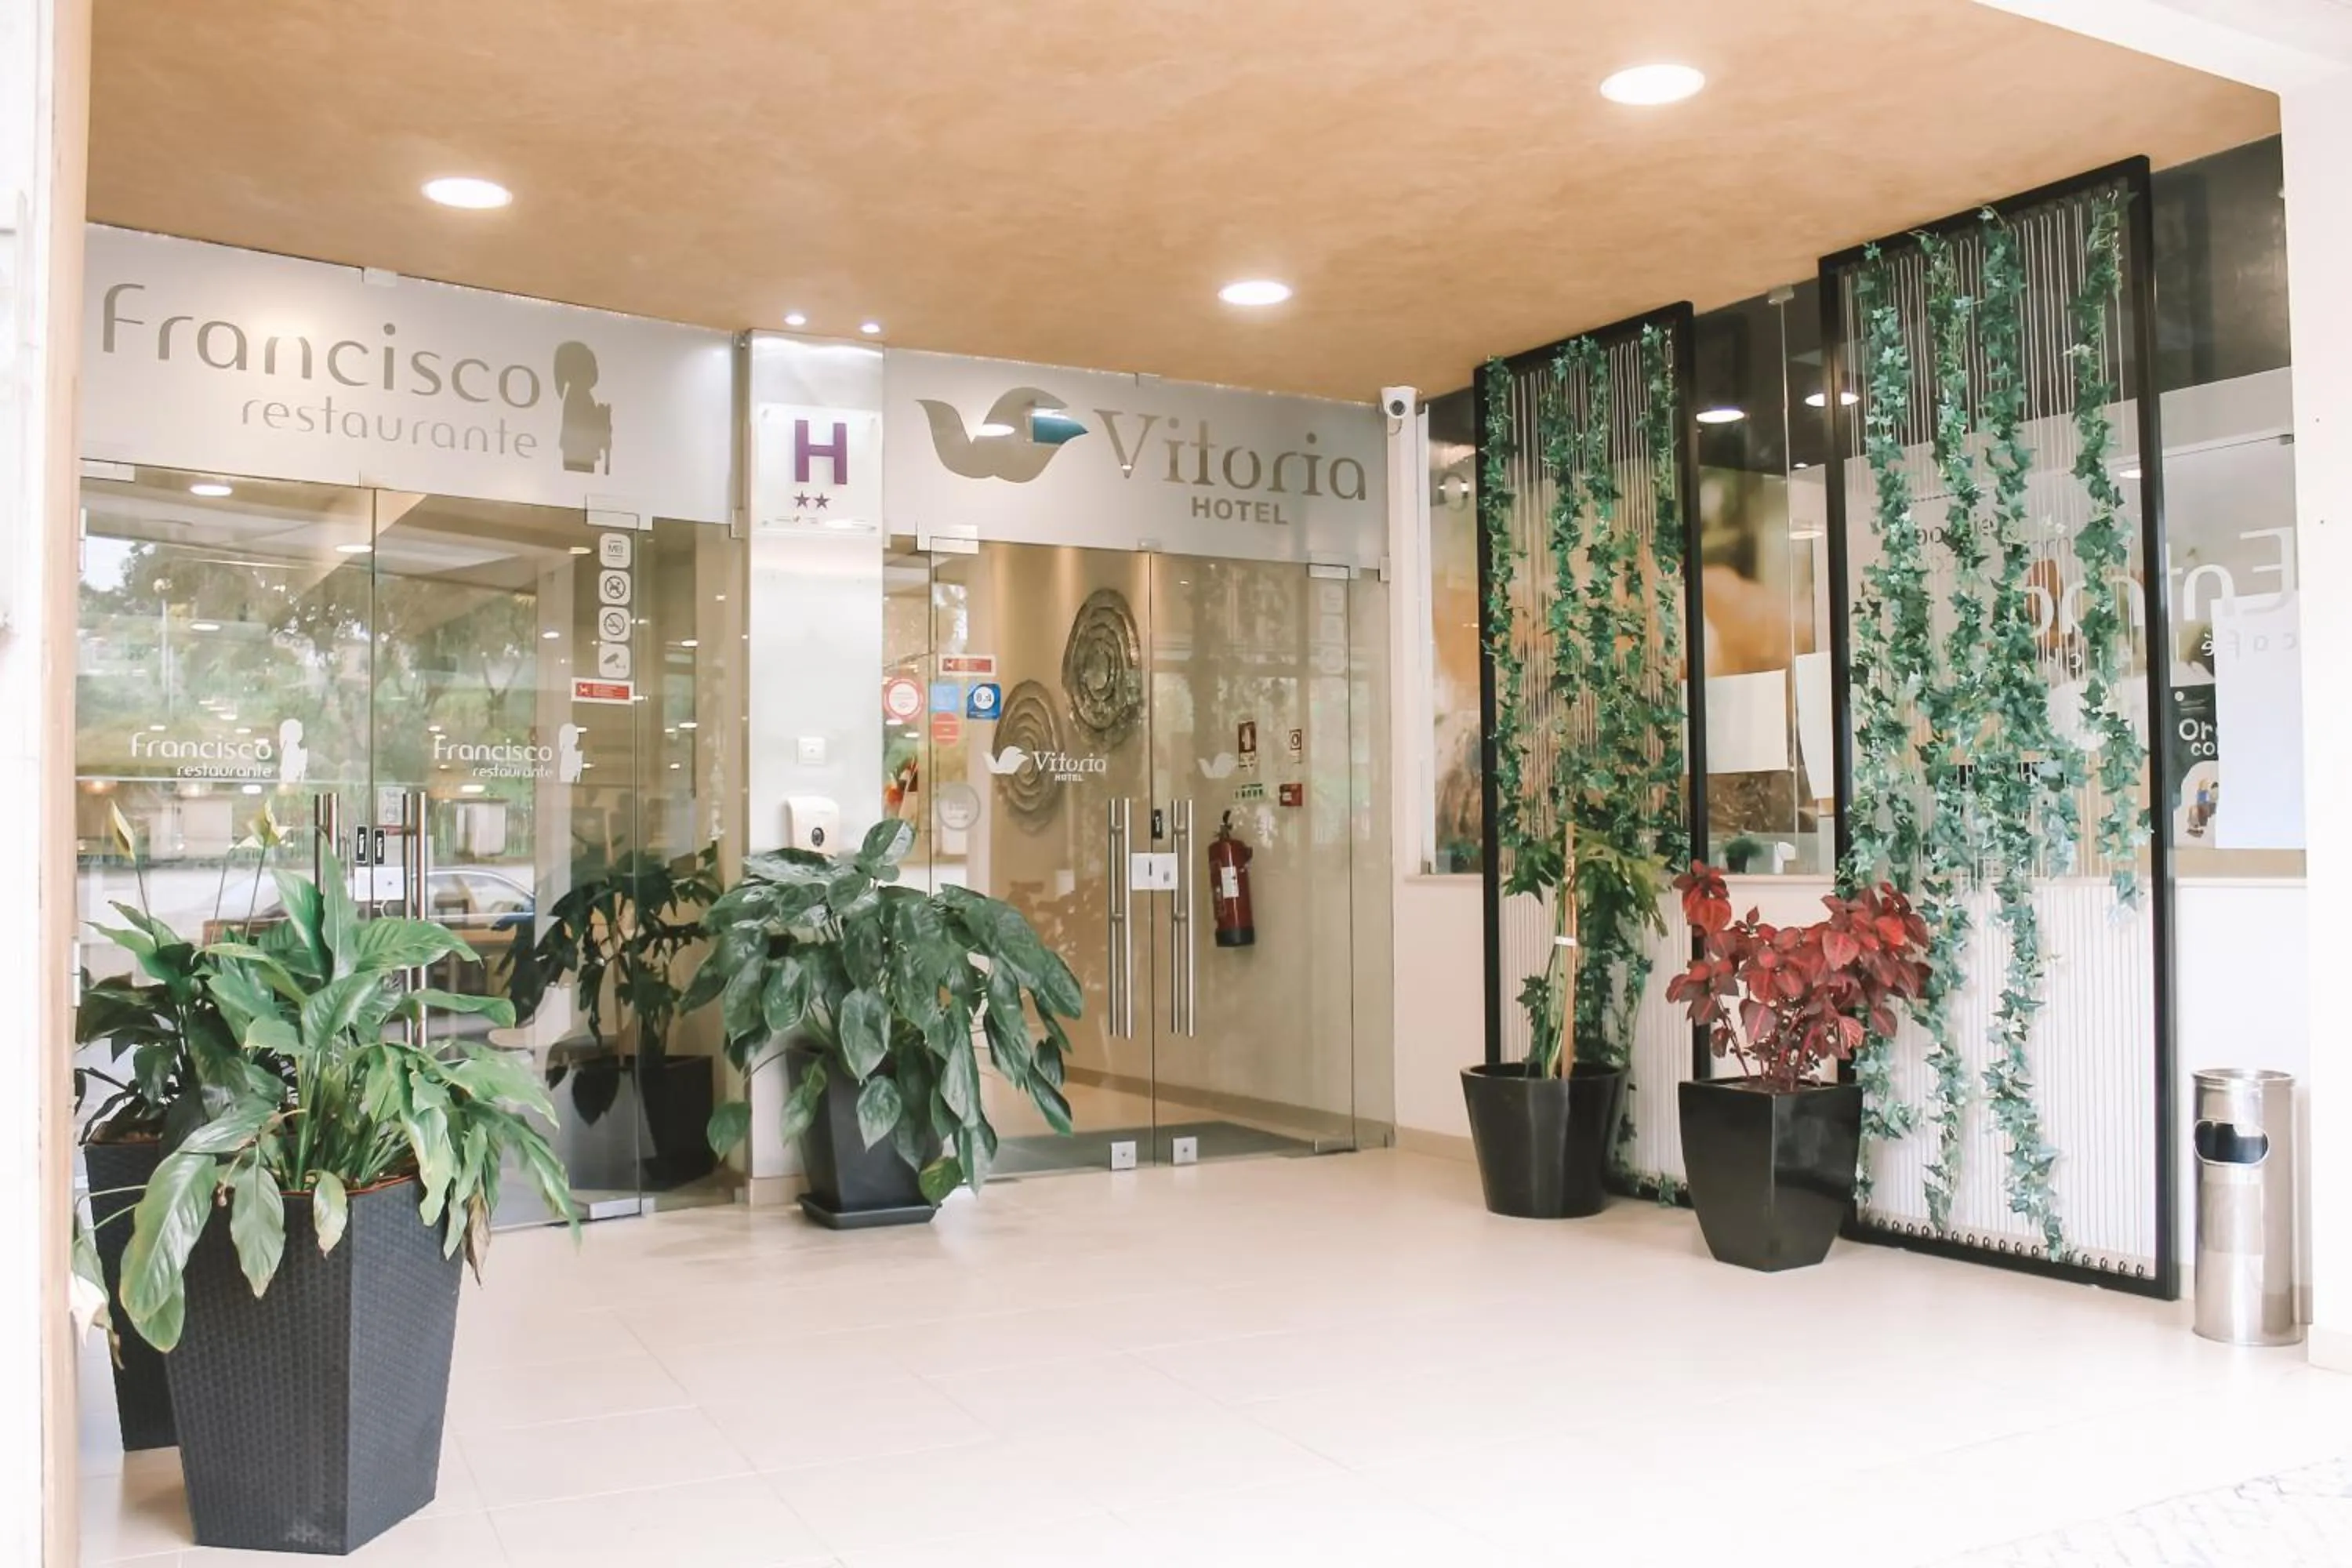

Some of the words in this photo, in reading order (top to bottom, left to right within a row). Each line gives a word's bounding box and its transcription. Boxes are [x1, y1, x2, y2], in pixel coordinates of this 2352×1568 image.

[102, 283, 541, 409] Francisco
[242, 395, 539, 459] restaurante
[793, 419, 848, 485] H
[1093, 408, 1367, 502] Vitoria
[1191, 496, 1288, 526] HOTEL
[131, 731, 272, 760] Francisco
[434, 735, 553, 762] Francisco
[176, 764, 273, 778] restaurante
[473, 764, 554, 779] restaurante
[1032, 751, 1108, 772] Vitoria
